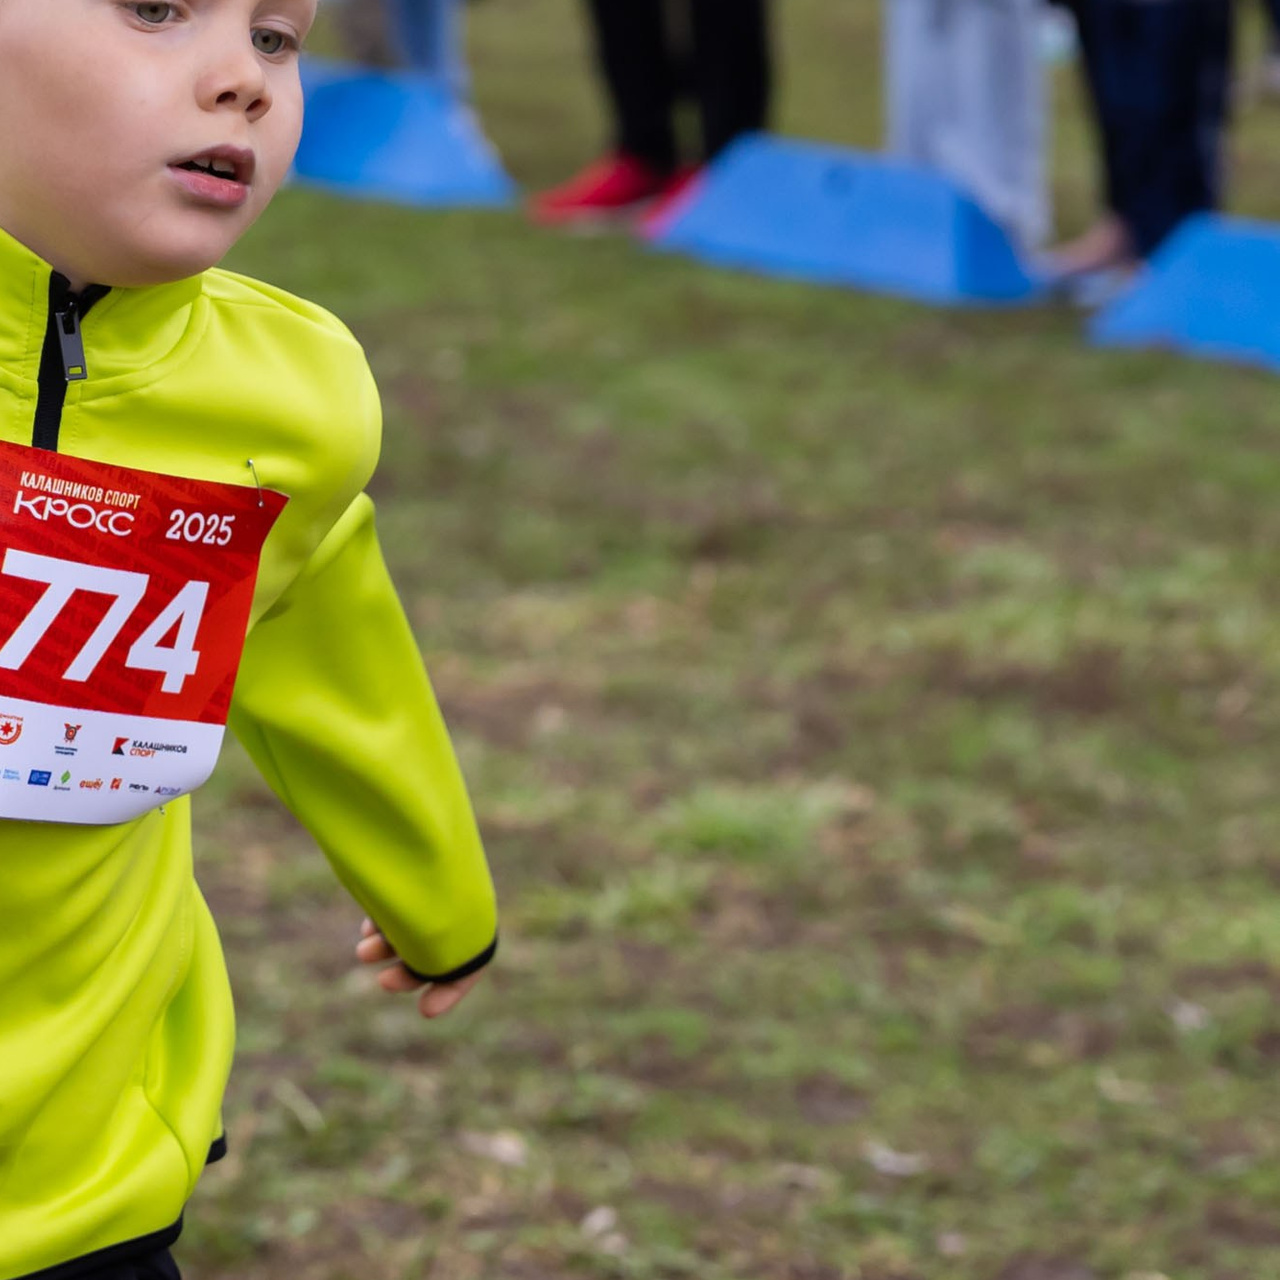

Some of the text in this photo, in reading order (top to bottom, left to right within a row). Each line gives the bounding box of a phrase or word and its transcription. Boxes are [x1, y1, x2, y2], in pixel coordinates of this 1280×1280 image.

[20, 471, 141, 510] КАЛАШНИКОВ СПОРТ
[13, 490, 135, 536] КРОСС
[165, 508, 236, 546] 2025
[129, 747, 156, 758] СПОРТ
[132, 740, 188, 754] КАЛАШНИКОВ
